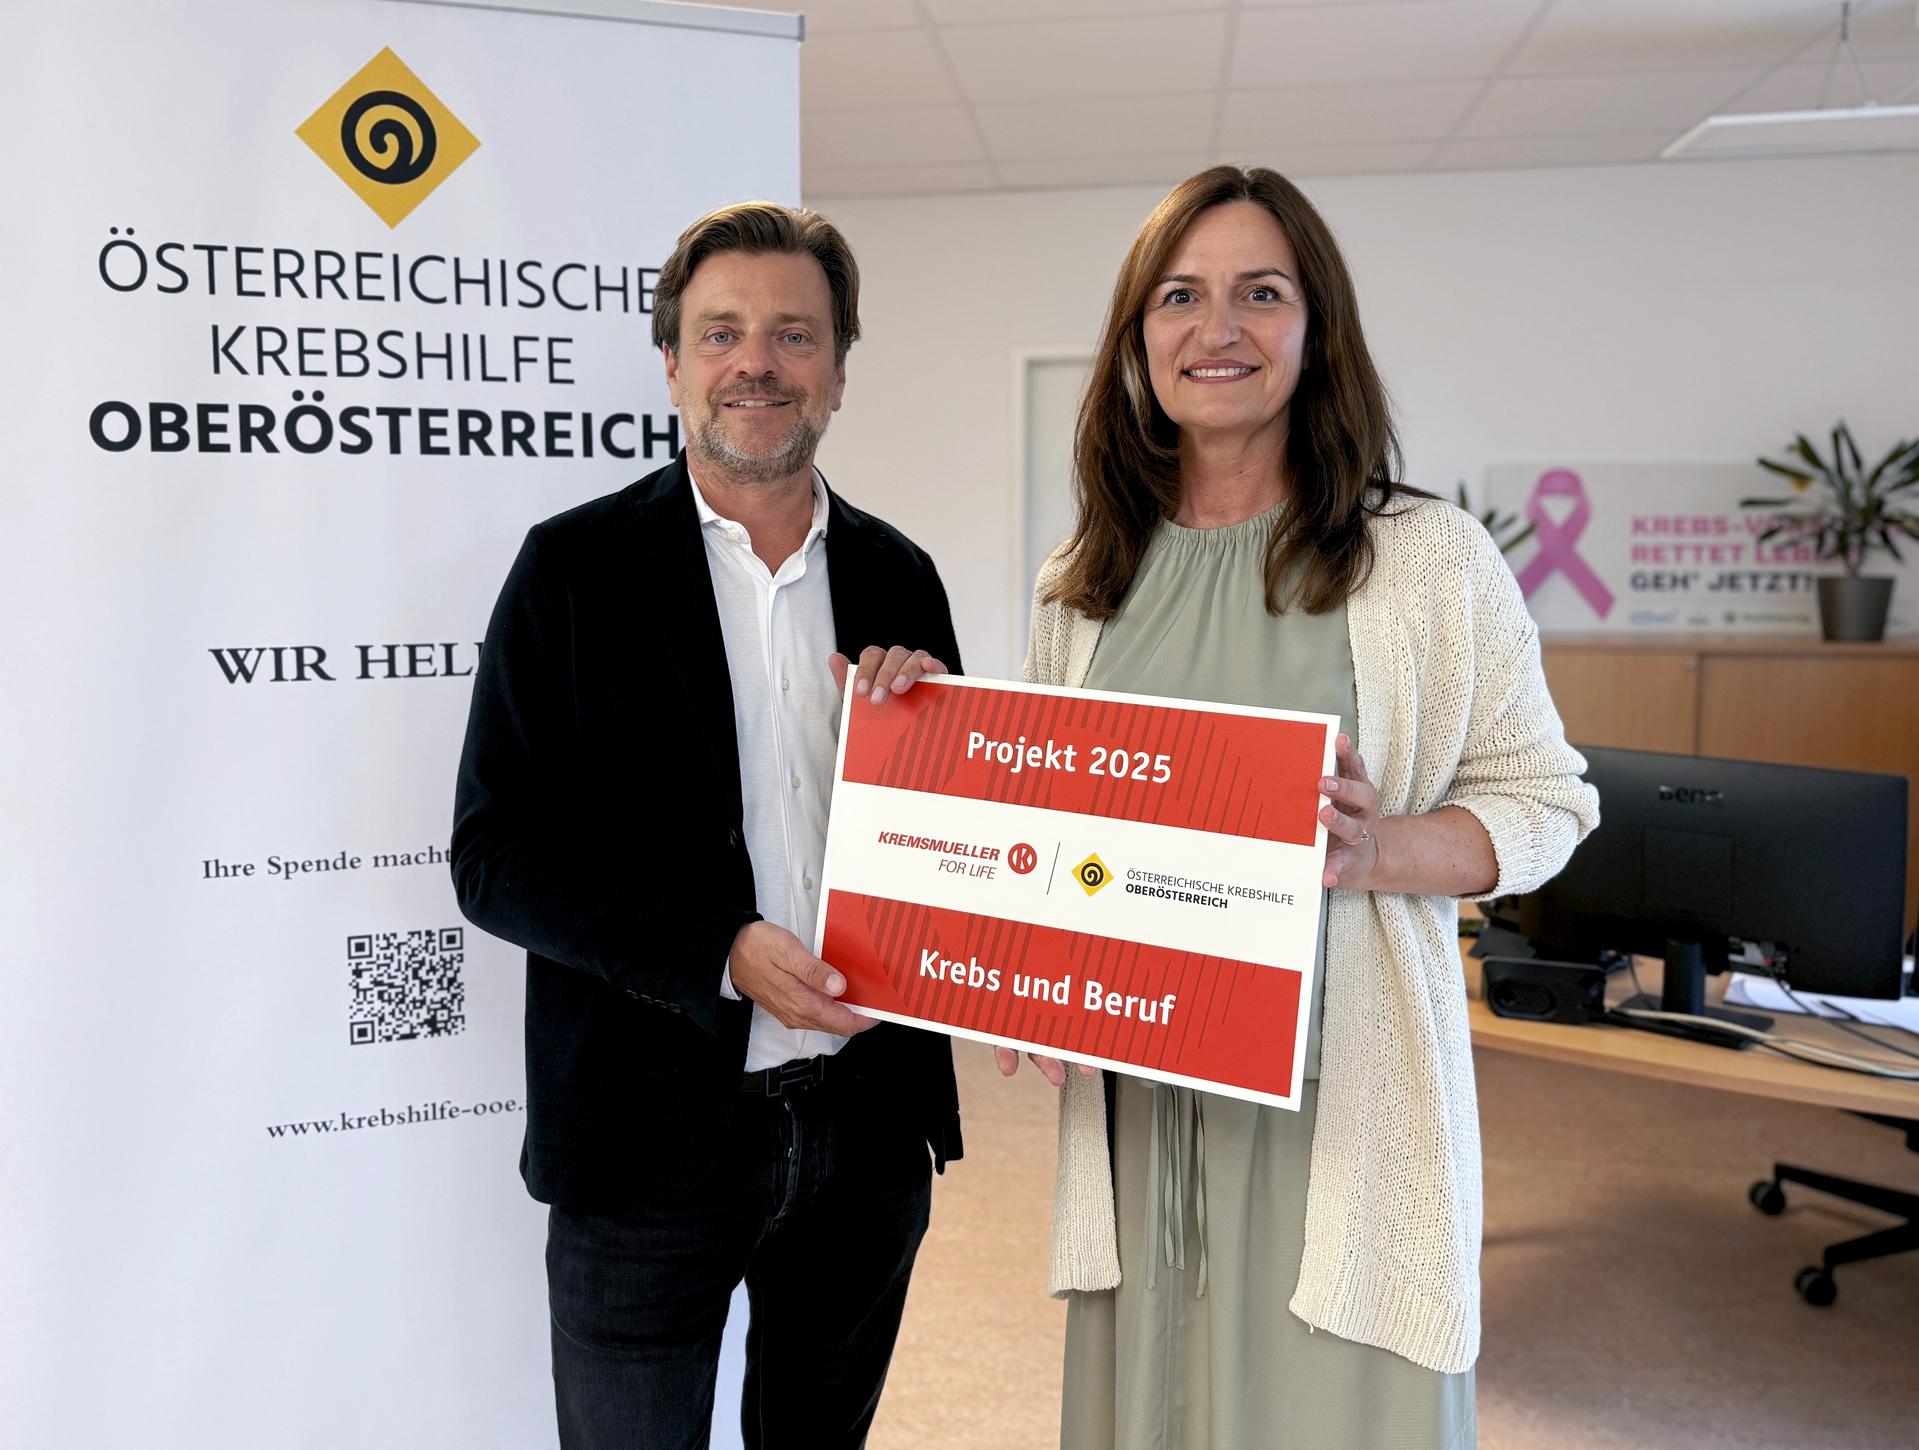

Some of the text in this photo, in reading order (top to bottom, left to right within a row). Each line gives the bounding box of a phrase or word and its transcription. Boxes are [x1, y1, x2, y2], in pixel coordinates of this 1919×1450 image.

[98, 226, 662, 314] ÖSTERREICHISCHE
[211, 324, 576, 385] KREBSHILFE
[88, 389, 679, 459] OBERÖSTERREICH
[1631, 543, 1745, 565] RETTET
[208, 641, 485, 685] WIR HEL
[967, 731, 1172, 784] Projekt 2025
[203, 845, 451, 880] Ihre Spende macht
[878, 831, 1000, 861] KREMSMUELLER
[938, 859, 997, 880] FOR LIFE
[1126, 867, 1295, 906] ÖSTERREICHISCHE KREBSHILFE
[1125, 883, 1228, 909] OBERÖSTERREICH
[919, 948, 1177, 1025] Krebs und Beruf
[266, 1099, 527, 1139] www.krebshilfe-ooe.
